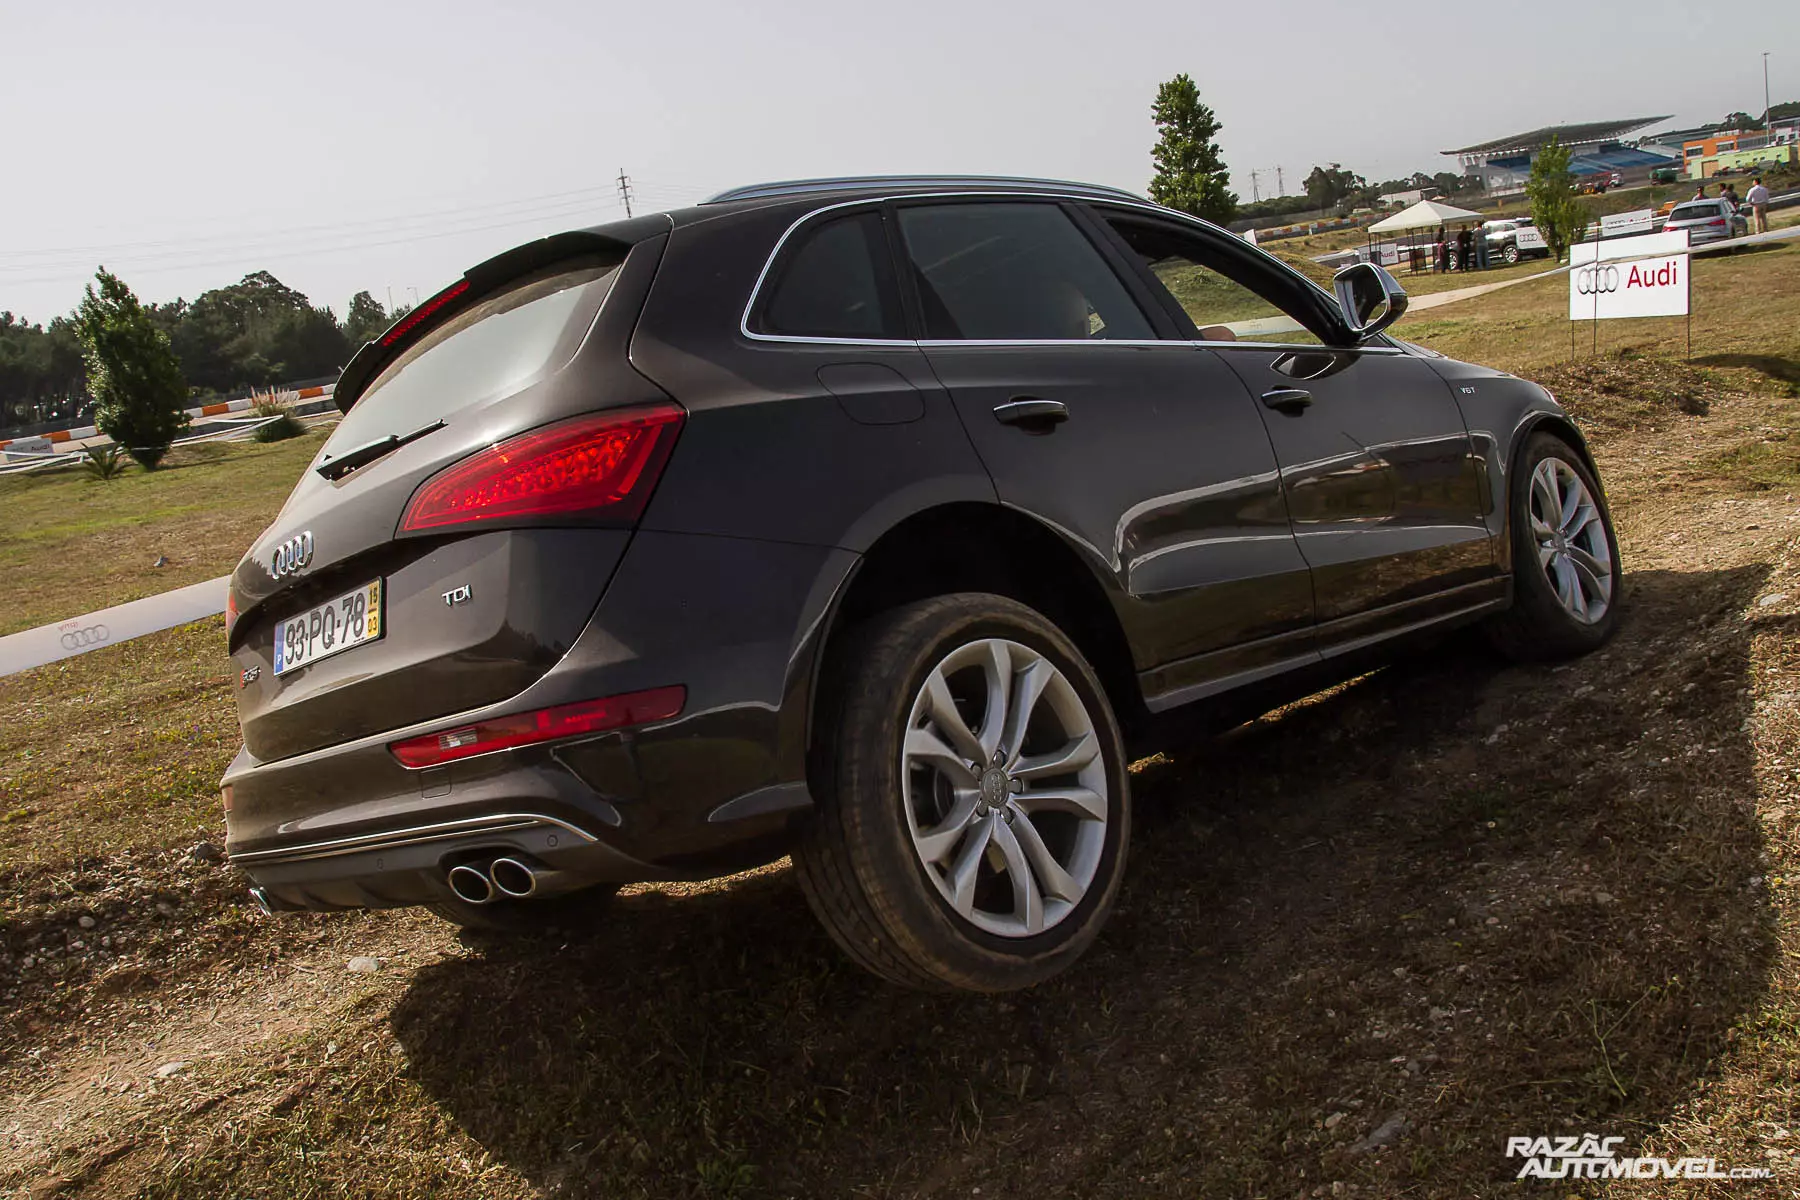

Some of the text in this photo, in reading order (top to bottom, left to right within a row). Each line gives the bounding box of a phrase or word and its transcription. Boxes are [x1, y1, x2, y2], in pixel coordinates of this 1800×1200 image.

[1626, 260, 1677, 289] Audi
[369, 586, 378, 606] 15
[441, 584, 472, 606] TDI
[285, 592, 366, 665] 93-PQ-78
[367, 616, 377, 633] 03
[277, 653, 282, 665] P
